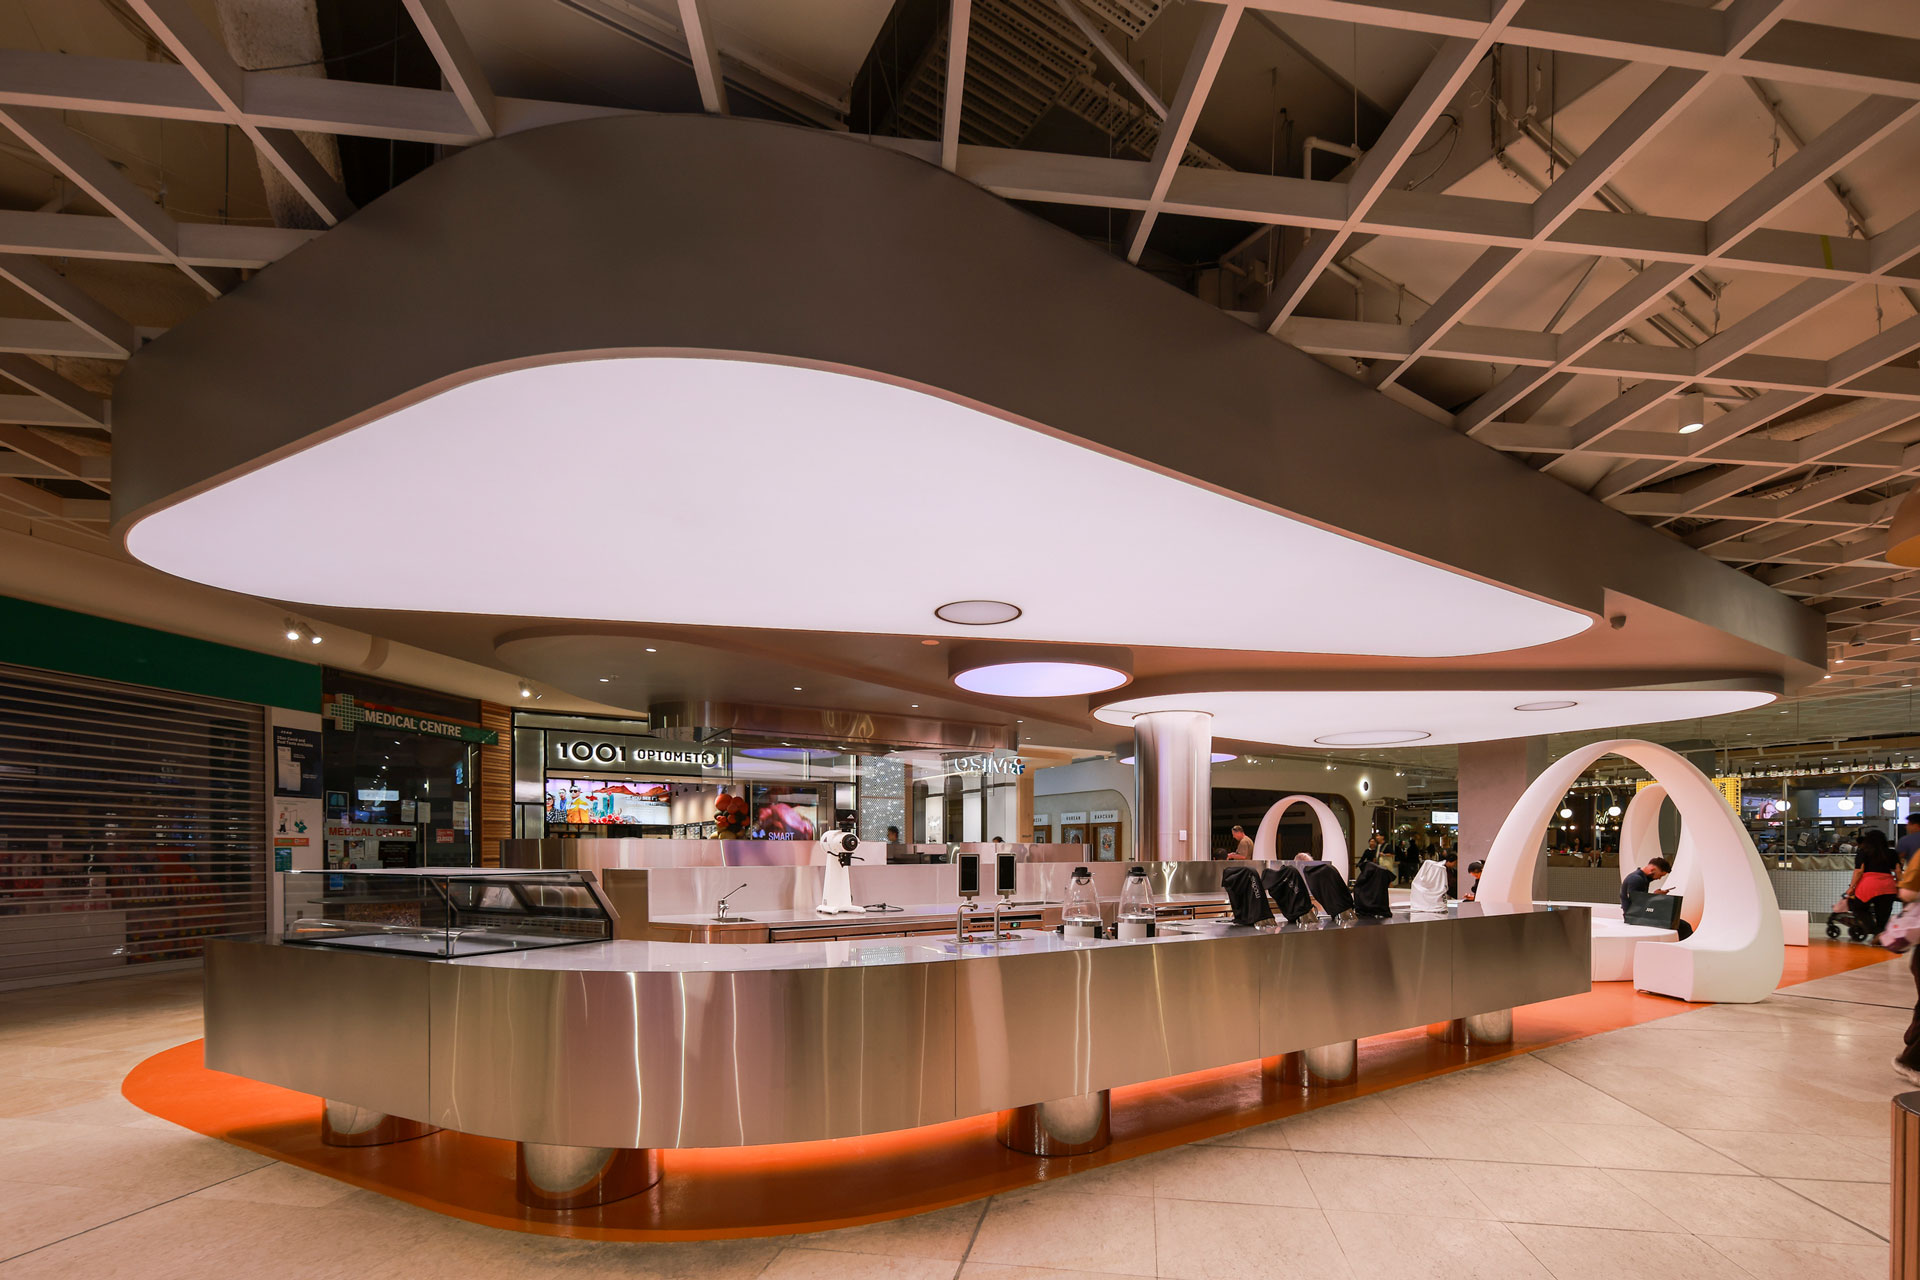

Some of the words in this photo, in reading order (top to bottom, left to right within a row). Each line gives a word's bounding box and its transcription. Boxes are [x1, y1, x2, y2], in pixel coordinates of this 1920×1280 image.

[364, 710, 417, 730] MEDICAL
[419, 720, 462, 737] CENTRE
[560, 741, 626, 762] 1001
[955, 758, 1007, 774] OSIM
[329, 827, 374, 837] MEDICAL
[376, 828, 412, 837] CENTRE
[768, 832, 795, 840] SMART
